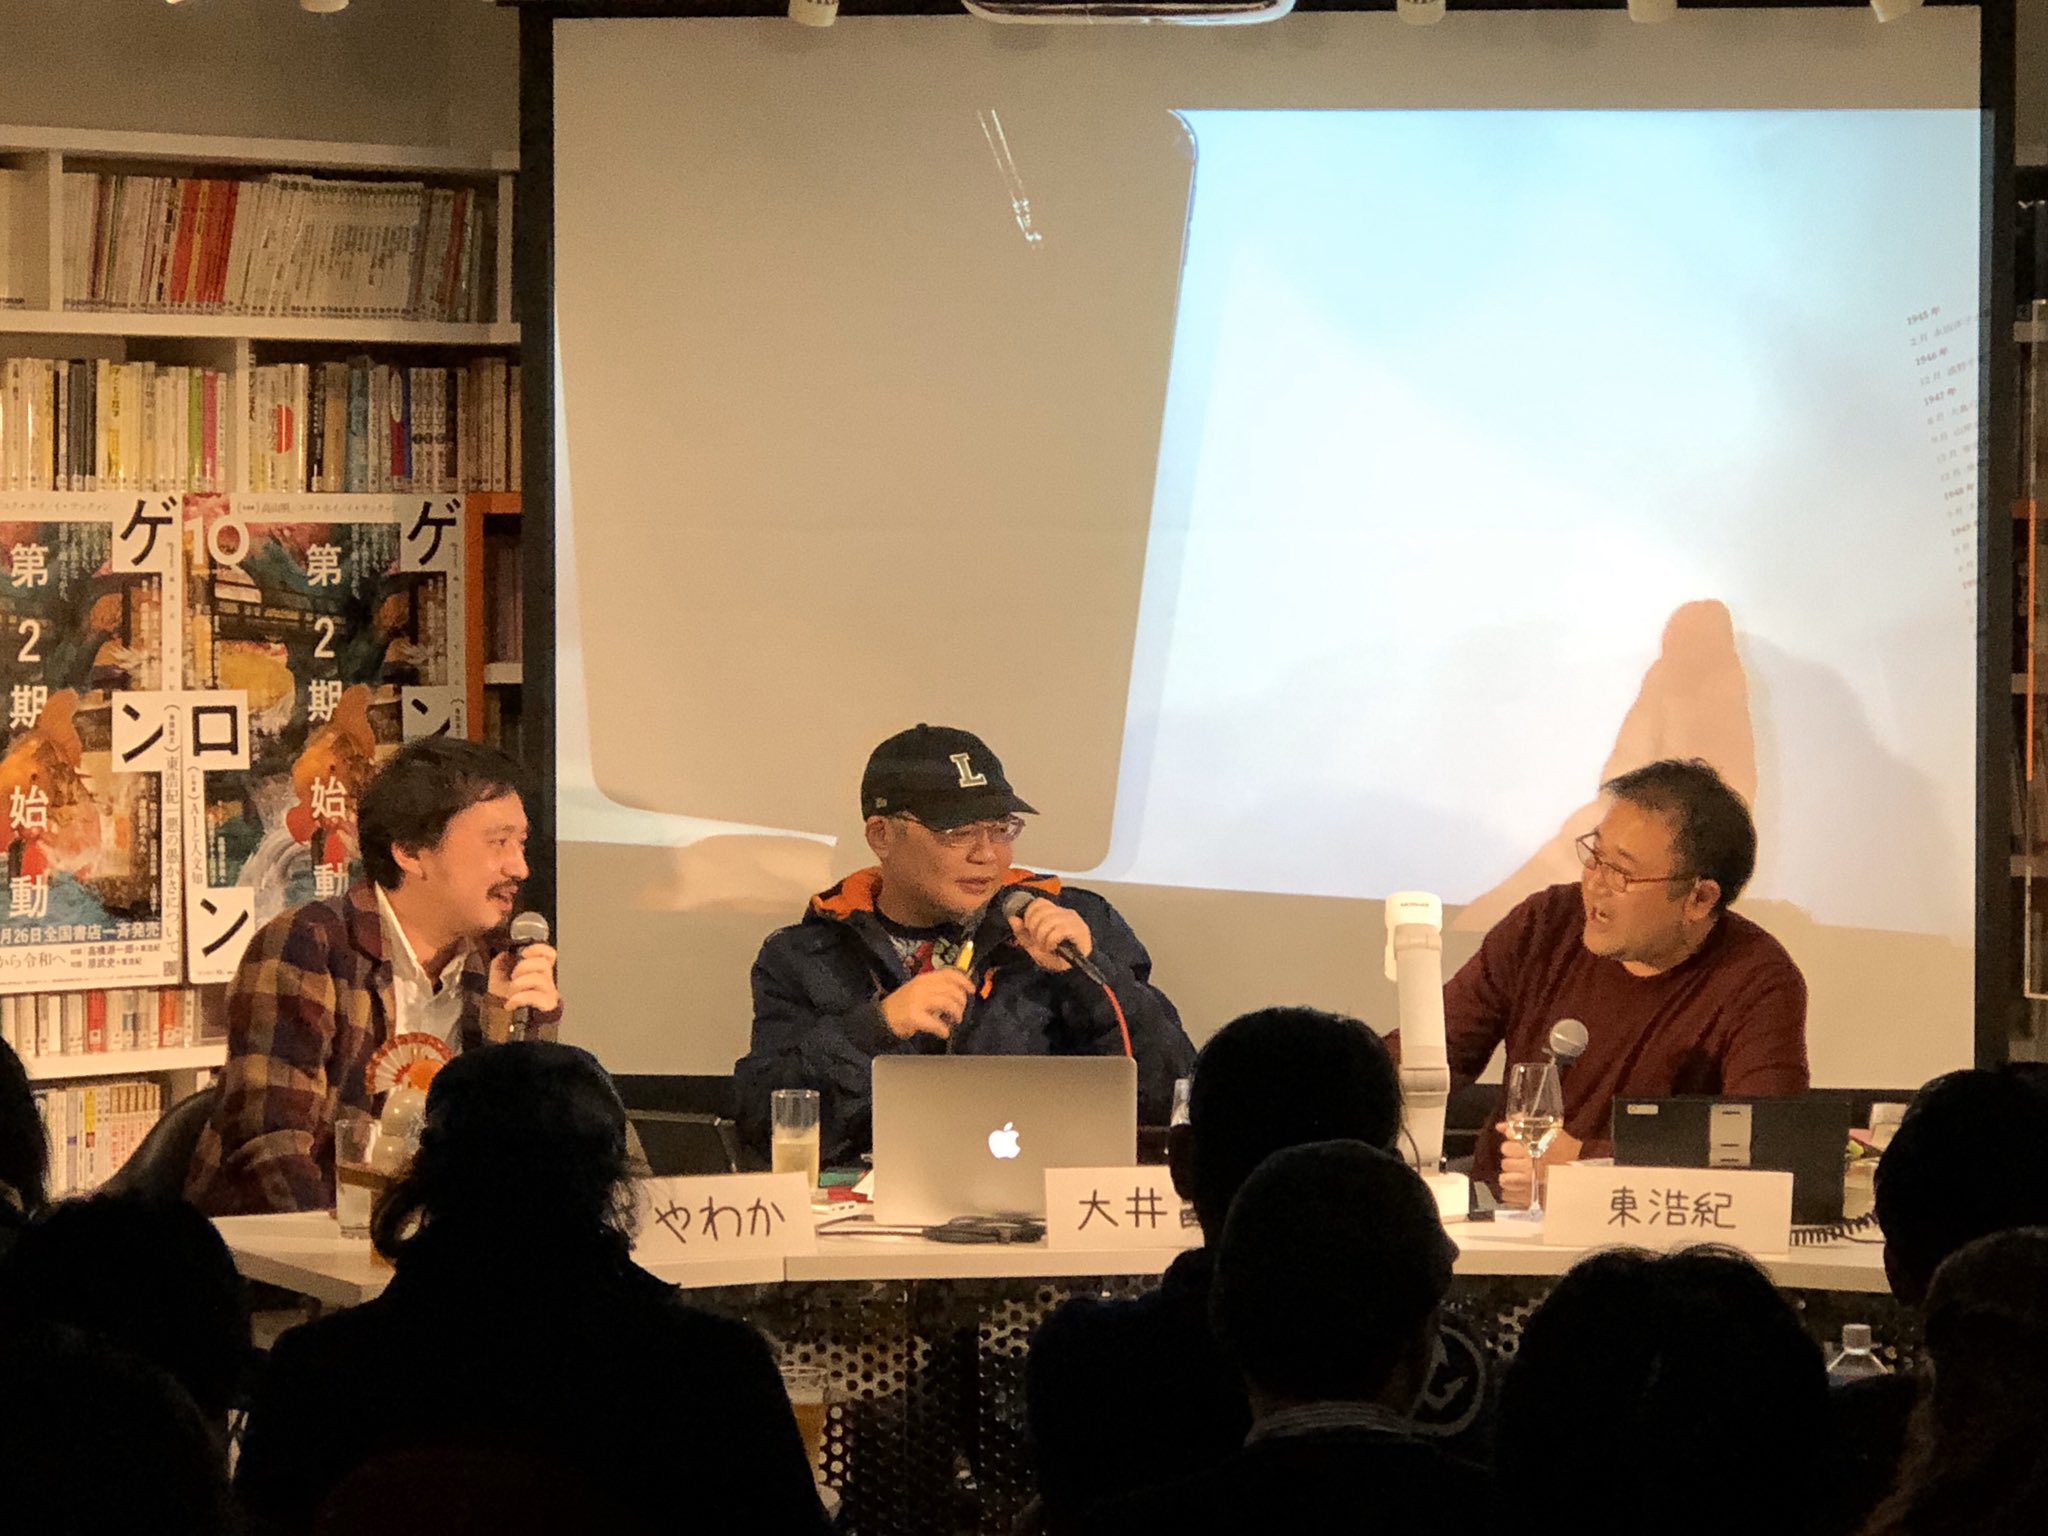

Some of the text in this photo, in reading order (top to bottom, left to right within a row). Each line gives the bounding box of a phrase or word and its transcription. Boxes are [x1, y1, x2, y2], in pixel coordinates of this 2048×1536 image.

[950, 752, 987, 788] L
[1608, 1186, 1736, 1228] 東浩紀
